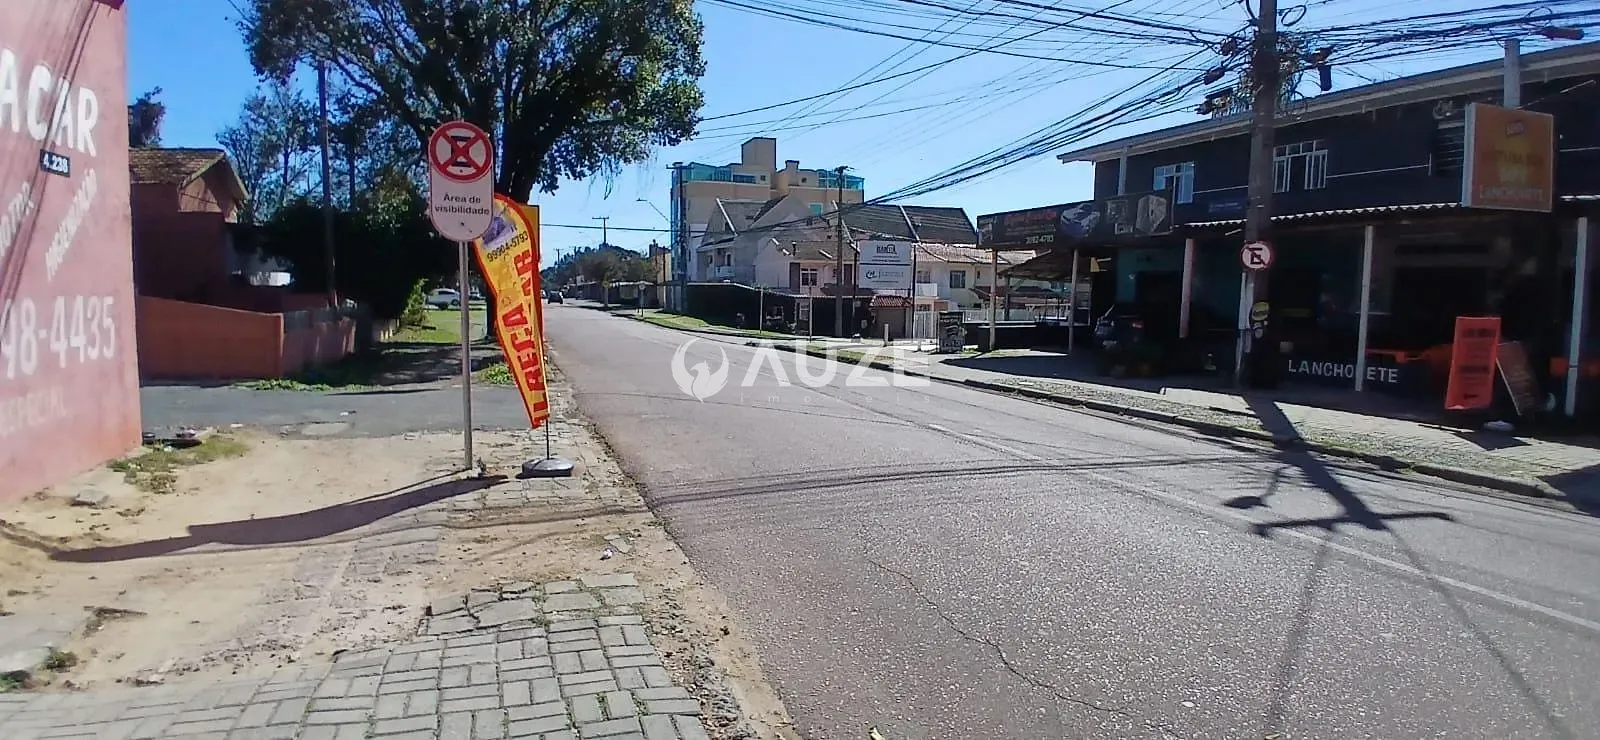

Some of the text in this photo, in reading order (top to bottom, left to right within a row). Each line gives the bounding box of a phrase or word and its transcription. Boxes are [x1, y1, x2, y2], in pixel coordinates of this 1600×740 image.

[469, 196, 481, 204] de
[434, 205, 489, 215] visibilidade
[1288, 359, 1399, 383] LANCHOETE
